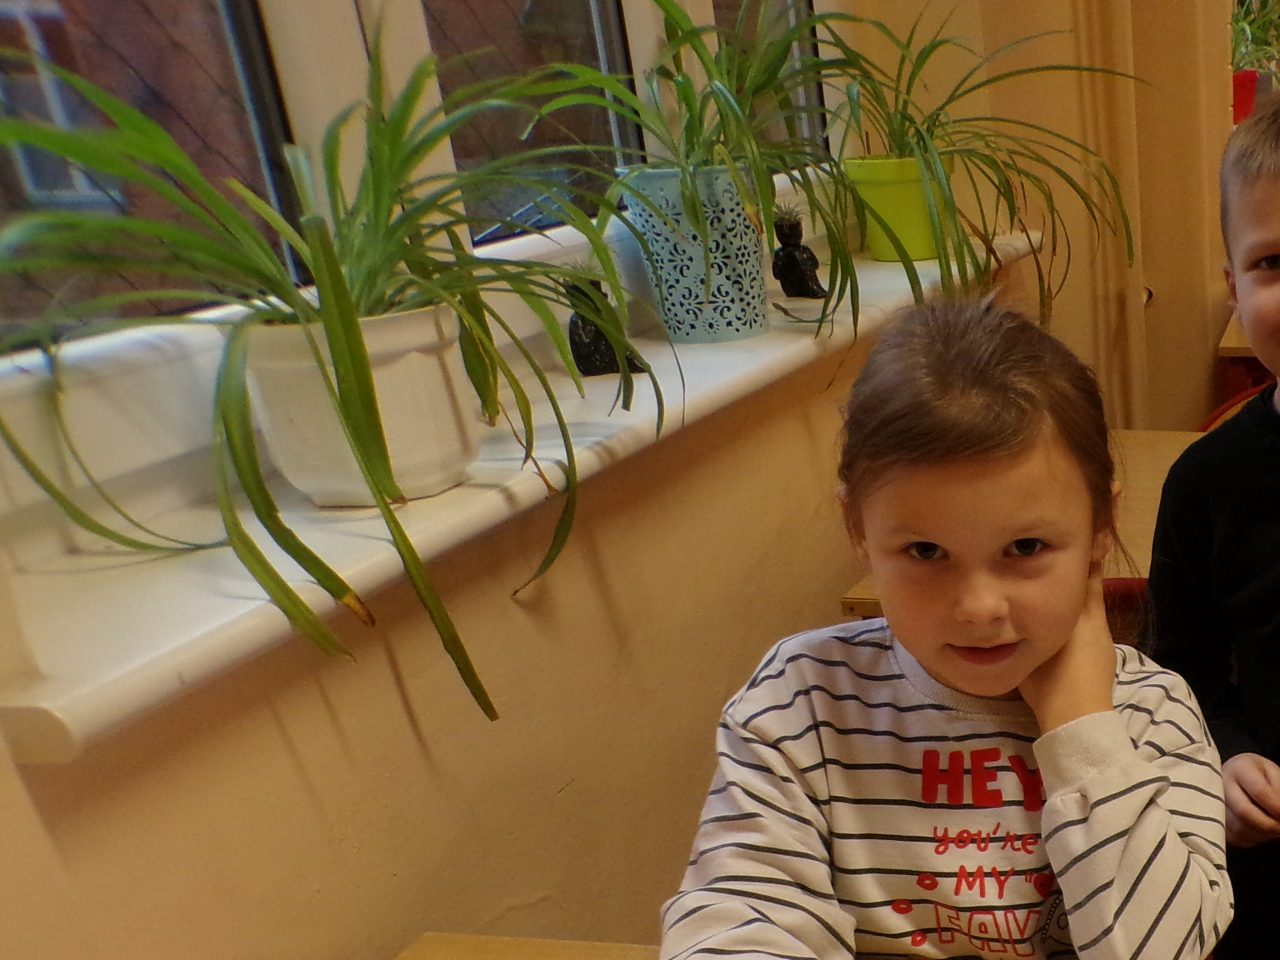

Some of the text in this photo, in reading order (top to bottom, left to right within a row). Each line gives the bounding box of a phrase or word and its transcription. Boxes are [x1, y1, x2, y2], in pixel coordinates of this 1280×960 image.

[921, 747, 1044, 812] HEY
[933, 822, 1041, 855] you're
[954, 865, 1015, 899] MY
[934, 902, 1042, 957] FAV
